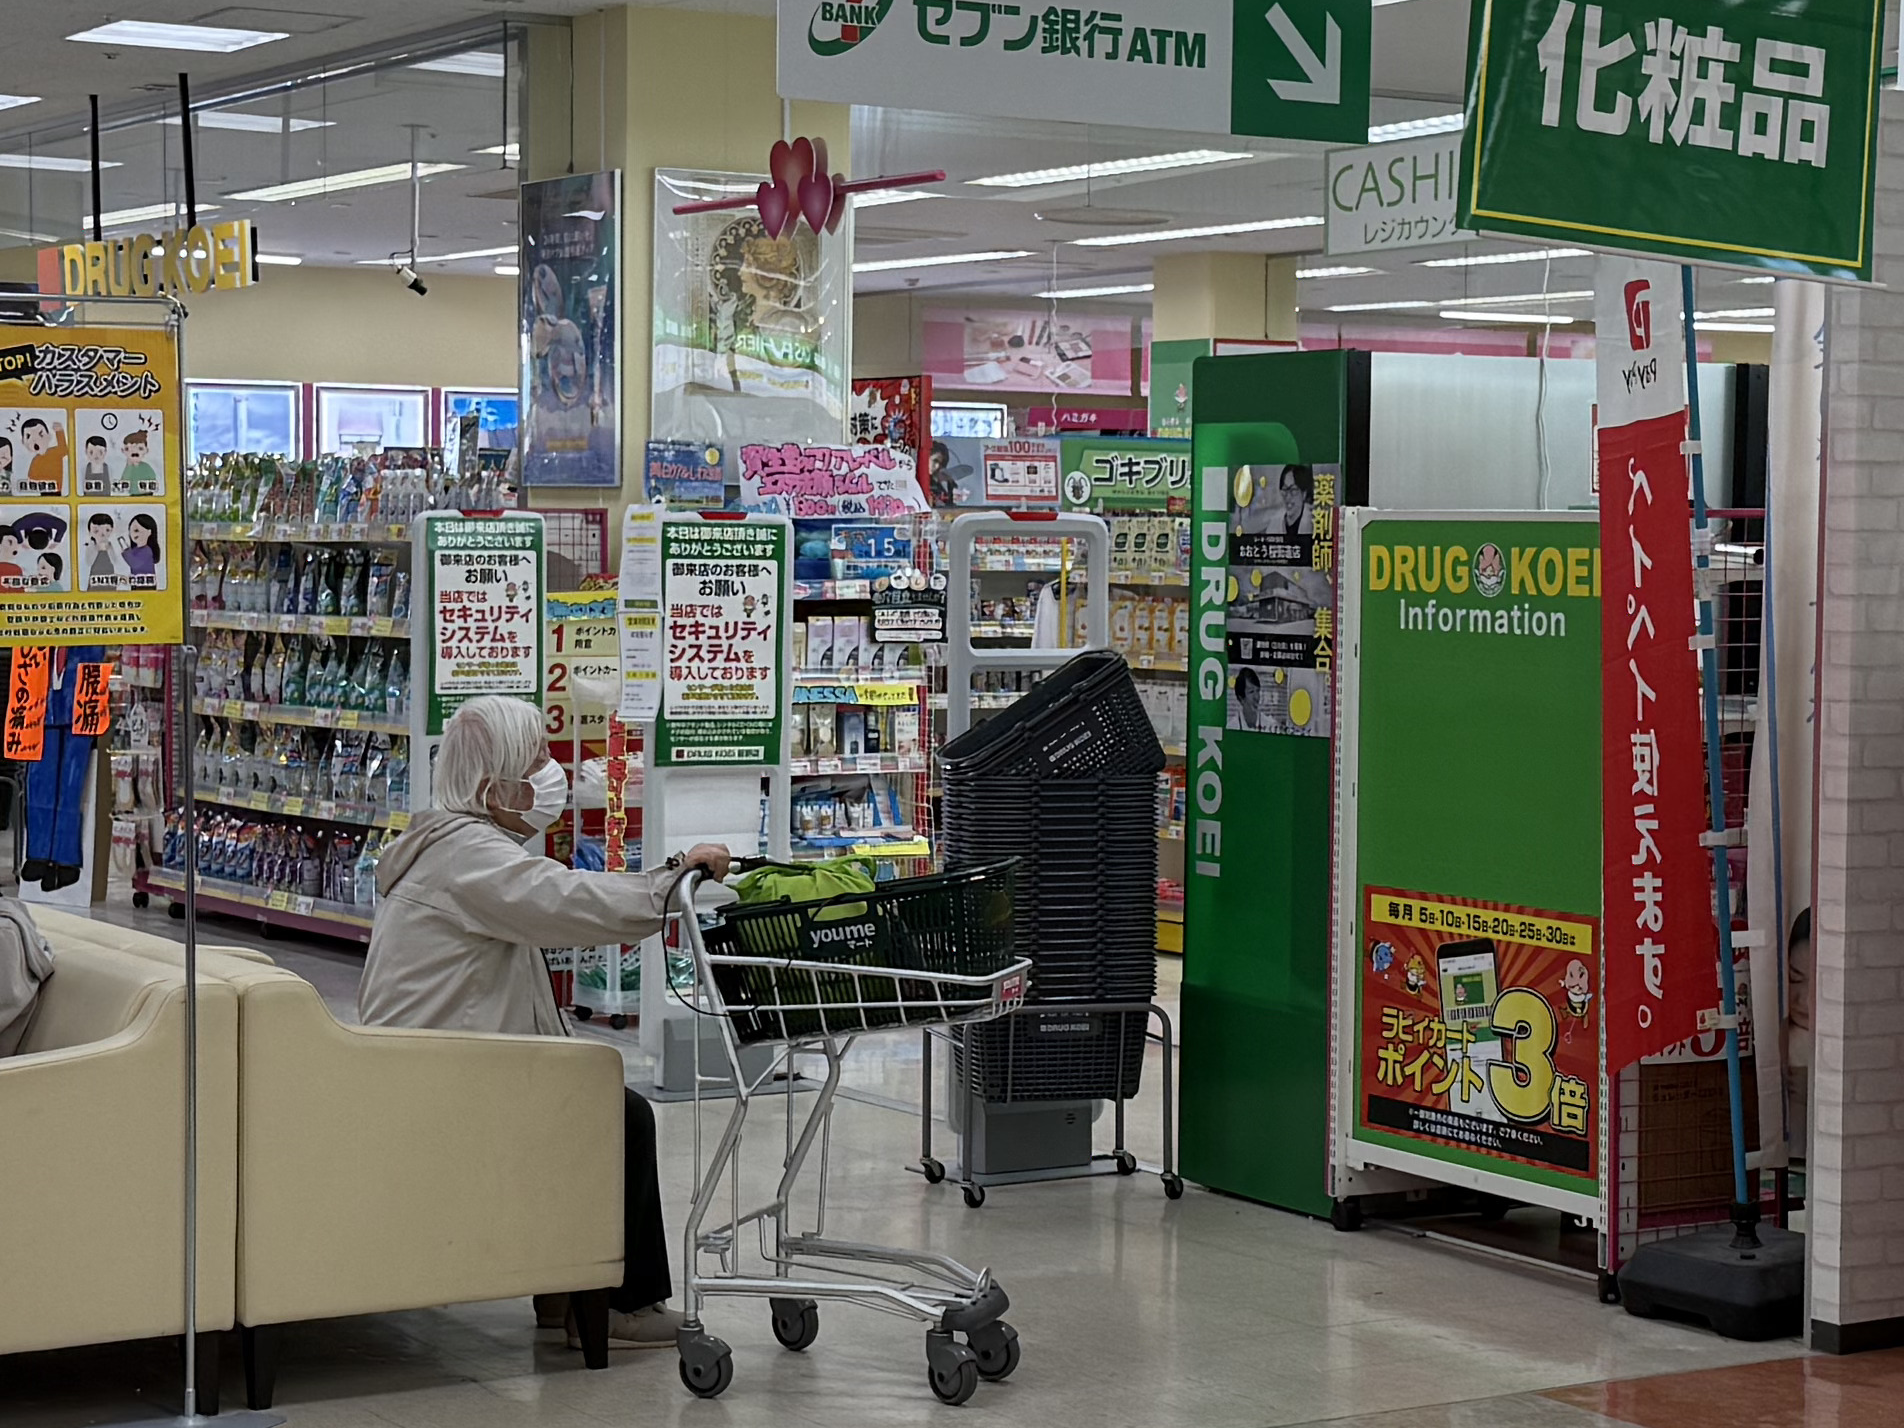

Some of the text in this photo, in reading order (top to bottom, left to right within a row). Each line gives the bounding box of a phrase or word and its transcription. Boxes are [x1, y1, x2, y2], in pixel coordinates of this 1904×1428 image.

[820, 0, 878, 27] BANK
[1126, 25, 1207, 69] ATM
[1537, 0, 1830, 169] 化粧品
[63, 218, 252, 298] DRUG KOEI
[33, 343, 148, 370] カスタマー
[28, 370, 161, 398] ハラスメント
[1060, 412, 1097, 424] ハミガキ
[1092, 456, 1190, 489] ゴキブリ
[437, 536, 534, 548] ありがとうございます
[668, 544, 775, 558] ありがとうございます
[439, 554, 532, 568] 御来店のお客様へ
[671, 561, 772, 578] 御来店のお客様へ
[1369, 545, 1601, 597] DRUG KOEI
[464, 568, 509, 585] お願い
[439, 590, 487, 605] 当店では
[698, 579, 748, 598] お願い
[439, 606, 532, 625] セキュリティ
[670, 603, 724, 620] 当店では
[1399, 599, 1566, 637] Information
[439, 625, 519, 645] システムを
[668, 621, 771, 643] セキュリティ
[440, 645, 533, 660] 導入しております
[668, 643, 755, 663] システムを
[669, 664, 771, 682] 導入しております
[1196, 521, 1228, 878] DRUG KOEI
[1387, 901, 1414, 922] 毎月
[809, 922, 877, 949] youme
[846, 940, 873, 949] マート
[1377, 1043, 1485, 1102] ポイント
